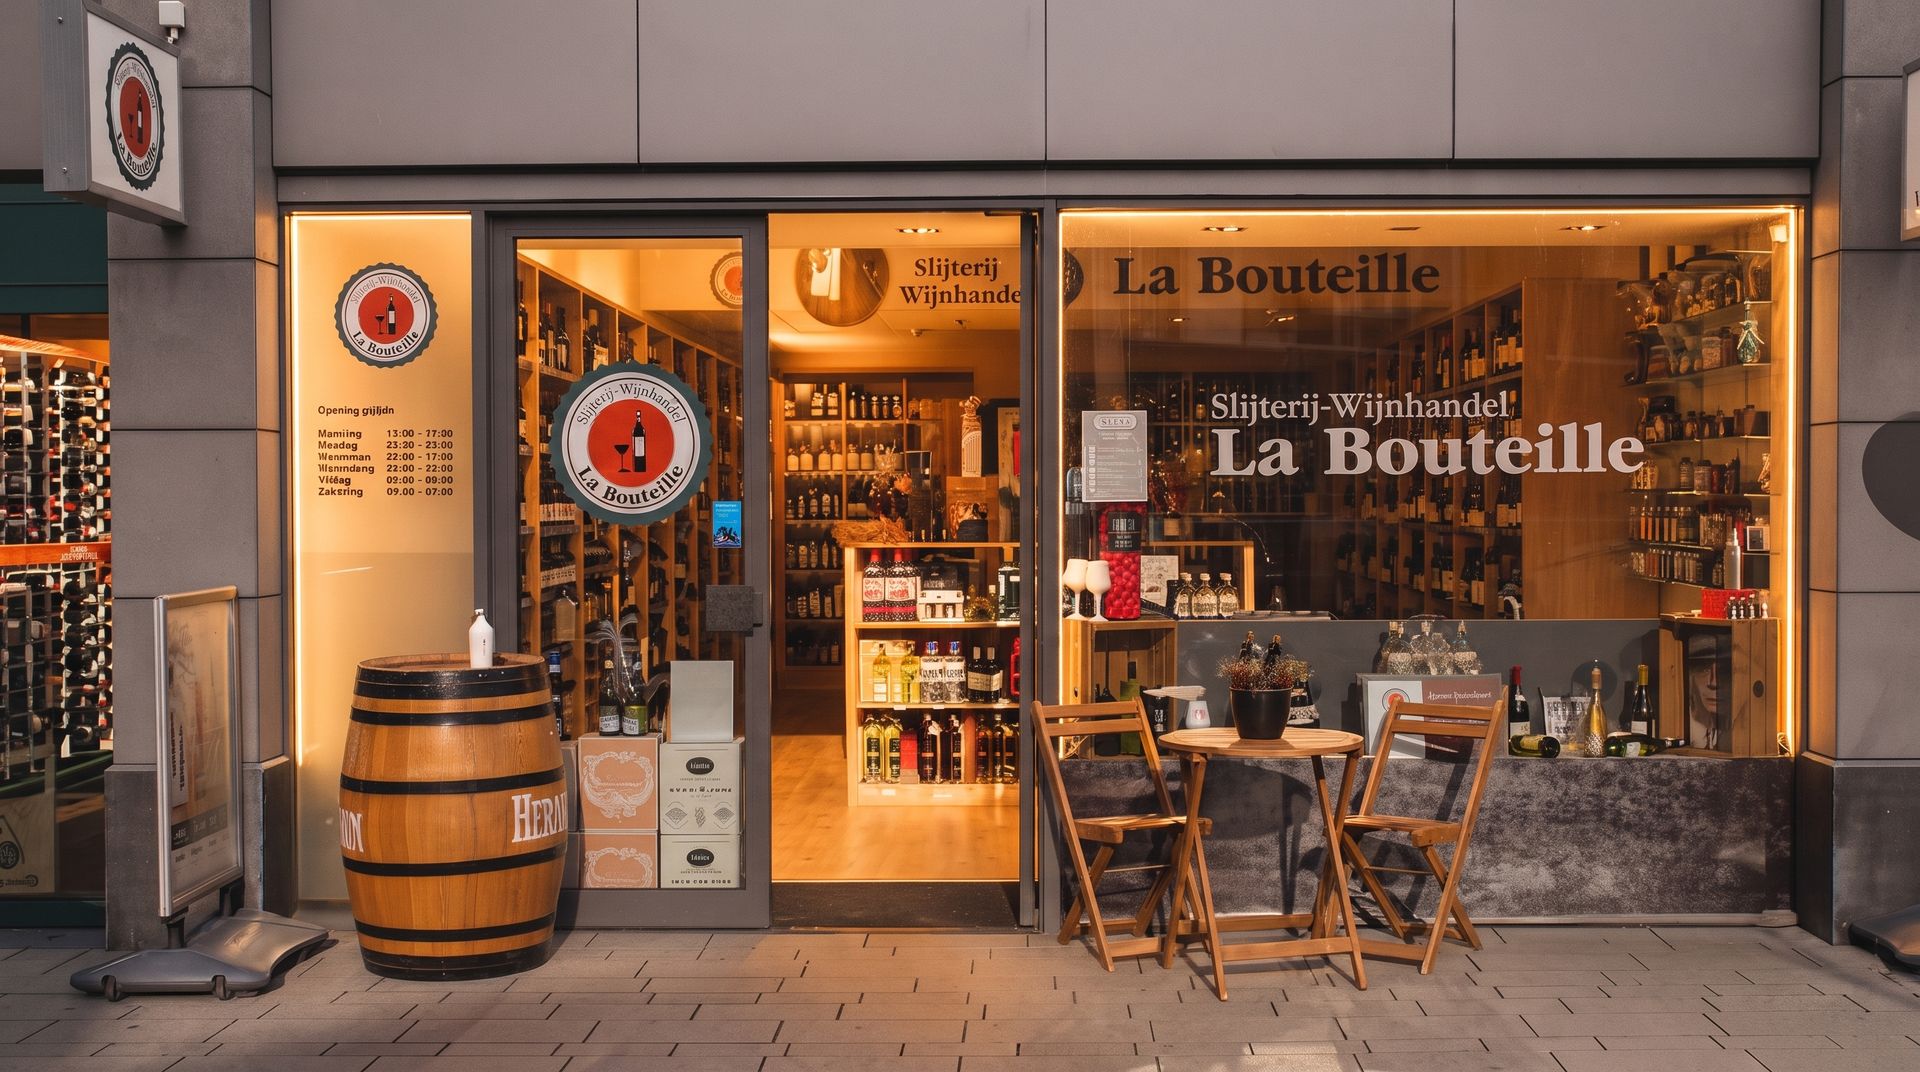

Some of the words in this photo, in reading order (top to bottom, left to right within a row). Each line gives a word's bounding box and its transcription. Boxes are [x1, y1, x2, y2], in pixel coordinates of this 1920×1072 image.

[914, 256, 998, 282] Slijterij
[1113, 257, 1180, 295] La
[1198, 252, 1440, 295] Bouteille
[899, 283, 1021, 310] Wijnhande
[353, 331, 364, 346] La
[367, 331, 419, 355] Bouteille
[317, 405, 359, 417] Opening
[576, 383, 687, 425] Slijterij-Wijnhandel
[1211, 390, 1509, 426] Slijterij-Wijnhandel
[386, 452, 415, 461] 22:00
[1211, 428, 1299, 476] La
[1324, 421, 1645, 476] Bouteille
[386, 464, 415, 473] 22:00
[425, 464, 454, 473] 22:00
[425, 487, 454, 496] 07:00
[578, 465, 598, 491] La
[602, 464, 683, 505] Bouteille
